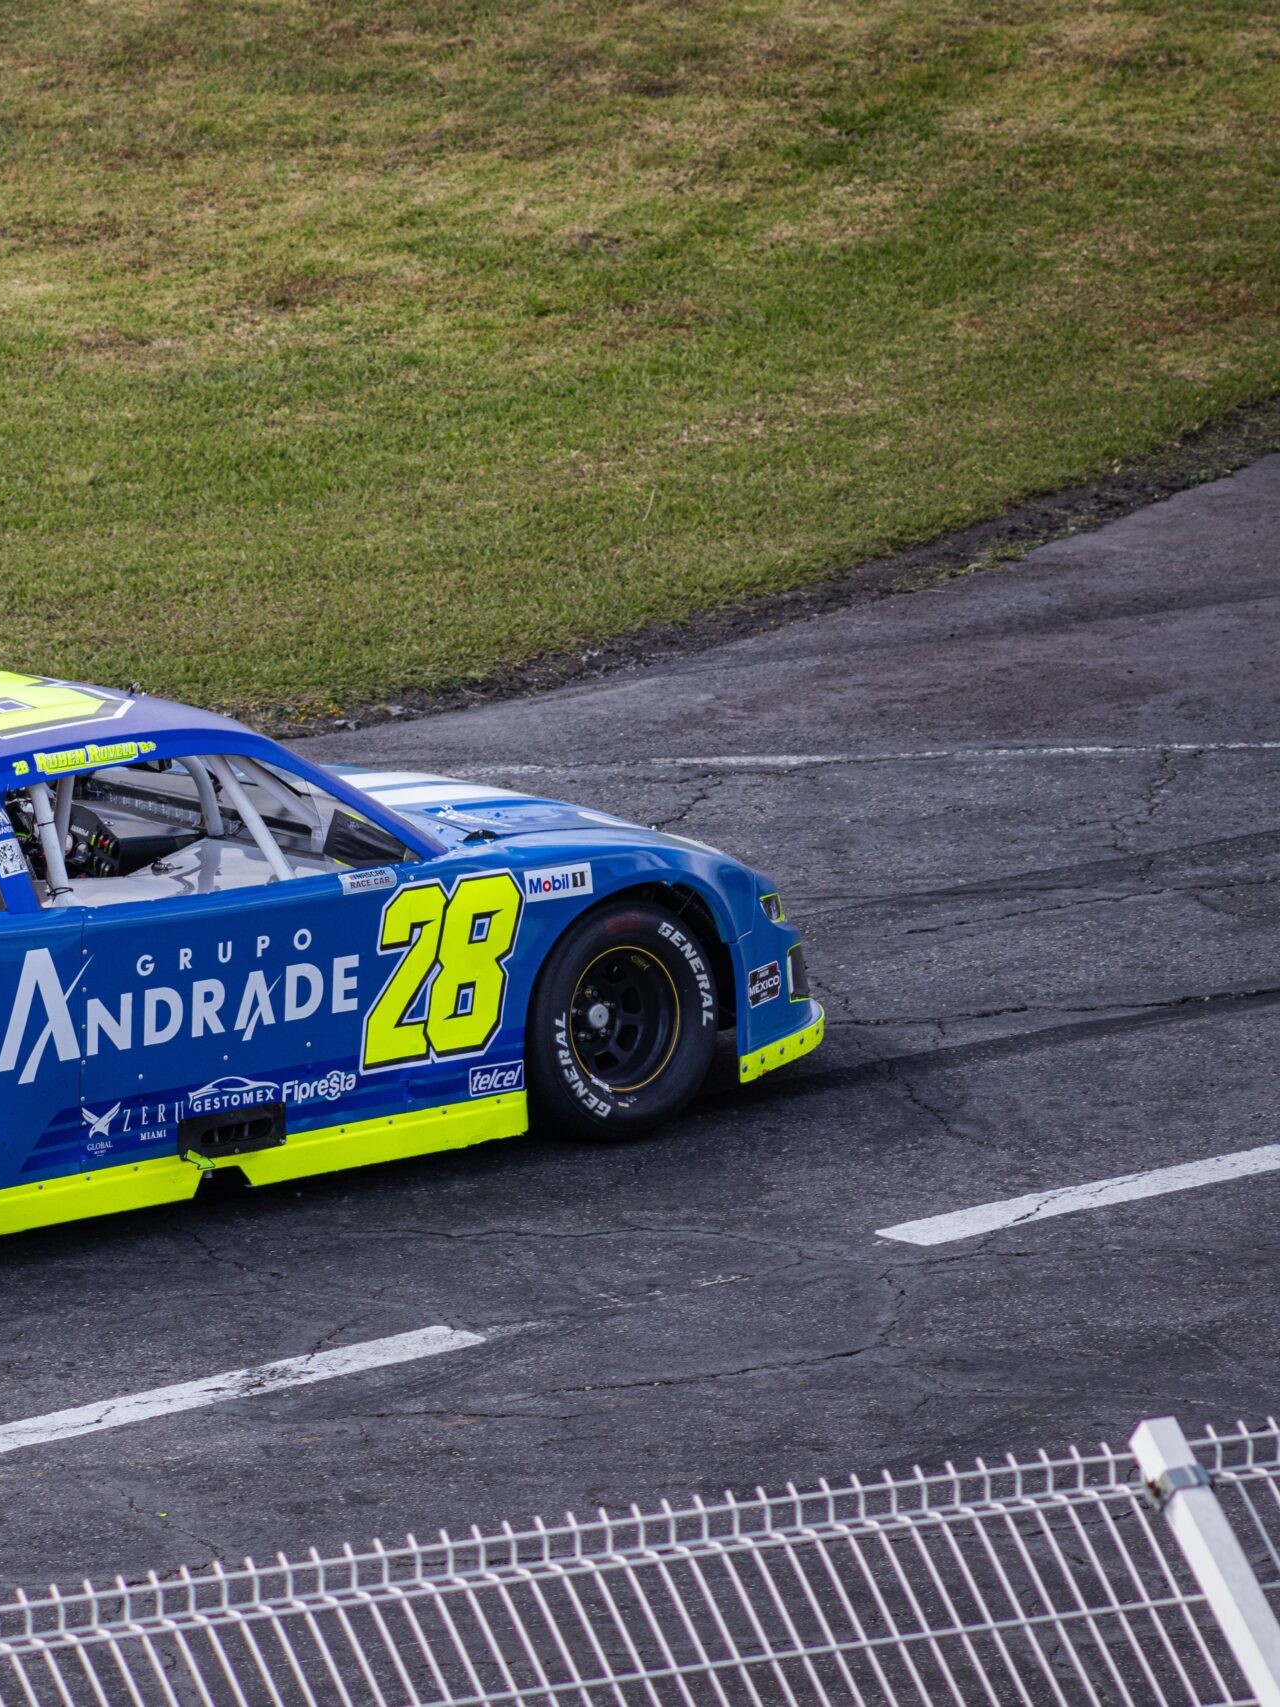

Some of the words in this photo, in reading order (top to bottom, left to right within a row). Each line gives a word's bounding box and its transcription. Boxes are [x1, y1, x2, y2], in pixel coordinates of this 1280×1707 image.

[33, 748, 86, 772] RUBEN
[86, 742, 137, 764] ROVELO
[350, 879, 371, 889] RACE
[373, 876, 390, 885] CAR
[355, 869, 387, 880] NASCAR
[528, 873, 570, 895] Mobil
[136, 928, 313, 977] GRUPO
[358, 867, 526, 1075] 28
[658, 921, 714, 1026] GENERAL
[554, 1011, 612, 1118] GENERAL
[472, 1064, 522, 1092] telcel
[193, 1089, 275, 1113] GESTOMEX
[87, 1141, 113, 1151] GLOBAL
[140, 1129, 167, 1141] MIAMI
